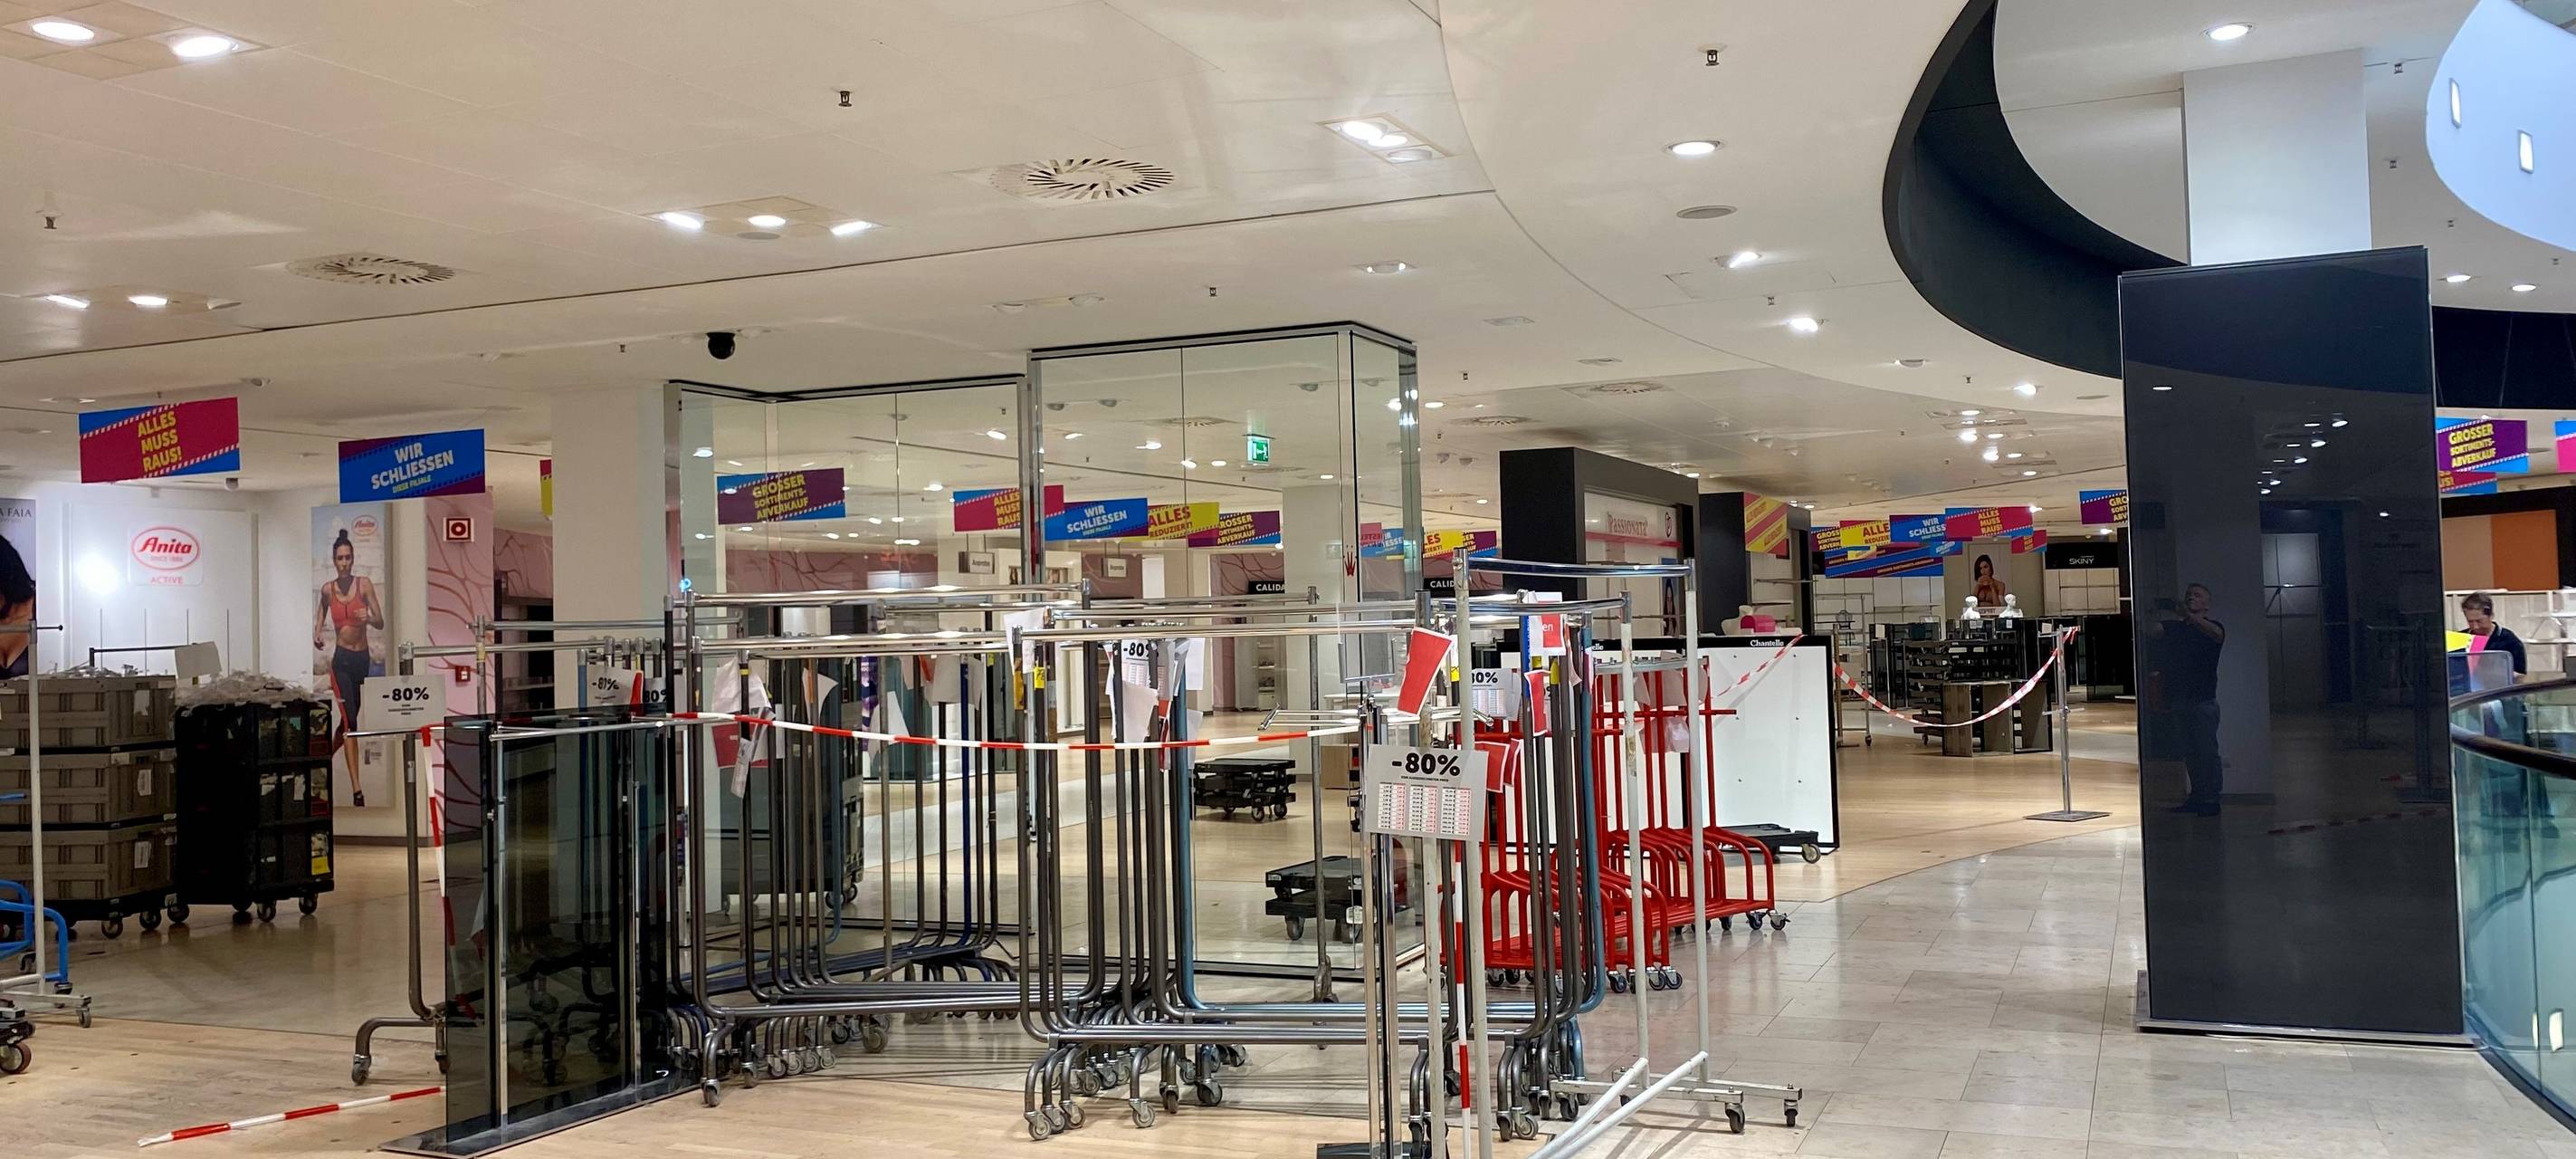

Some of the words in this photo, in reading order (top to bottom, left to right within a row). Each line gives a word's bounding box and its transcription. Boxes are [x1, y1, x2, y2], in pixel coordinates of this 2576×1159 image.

[138, 410, 177, 437] ALLES
[141, 429, 178, 454] MUSS
[2448, 423, 2494, 445] GROSSER
[143, 445, 183, 472] RAUS!
[395, 442, 424, 464] WIR
[2451, 448, 2496, 468] ABVERKAUF
[371, 450, 454, 490] SCHLIESSEN
[752, 474, 806, 497] GROSSER
[754, 488, 806, 508] SORTIMENTS-
[994, 492, 1020, 507] ALLES
[7, 507, 32, 518] FAIA
[757, 497, 808, 520] ABVERKAUF
[1084, 505, 1105, 518] WIR
[1148, 506, 1191, 527] ALLES
[1978, 510, 1999, 520] ALLES
[997, 512, 1021, 526] RAUS
[1067, 510, 1128, 533] SCHLIESSEN
[1219, 514, 1253, 530] ROSSER
[1922, 517, 1940, 527] WIR
[1980, 517, 2001, 527] MUSS
[1218, 523, 1255, 536] ORTIMENTS-
[1817, 530, 1840, 540] GROSS
[1863, 522, 1890, 537] ALLE
[1909, 523, 1947, 537] SCHLIESS
[1980, 524, 2003, 534] RAUS!
[139, 536, 193, 554] Anita
[150, 577, 183, 585] ACTIVE
[382, 687, 430, 702] -80%
[1391, 752, 1461, 777] -80%
